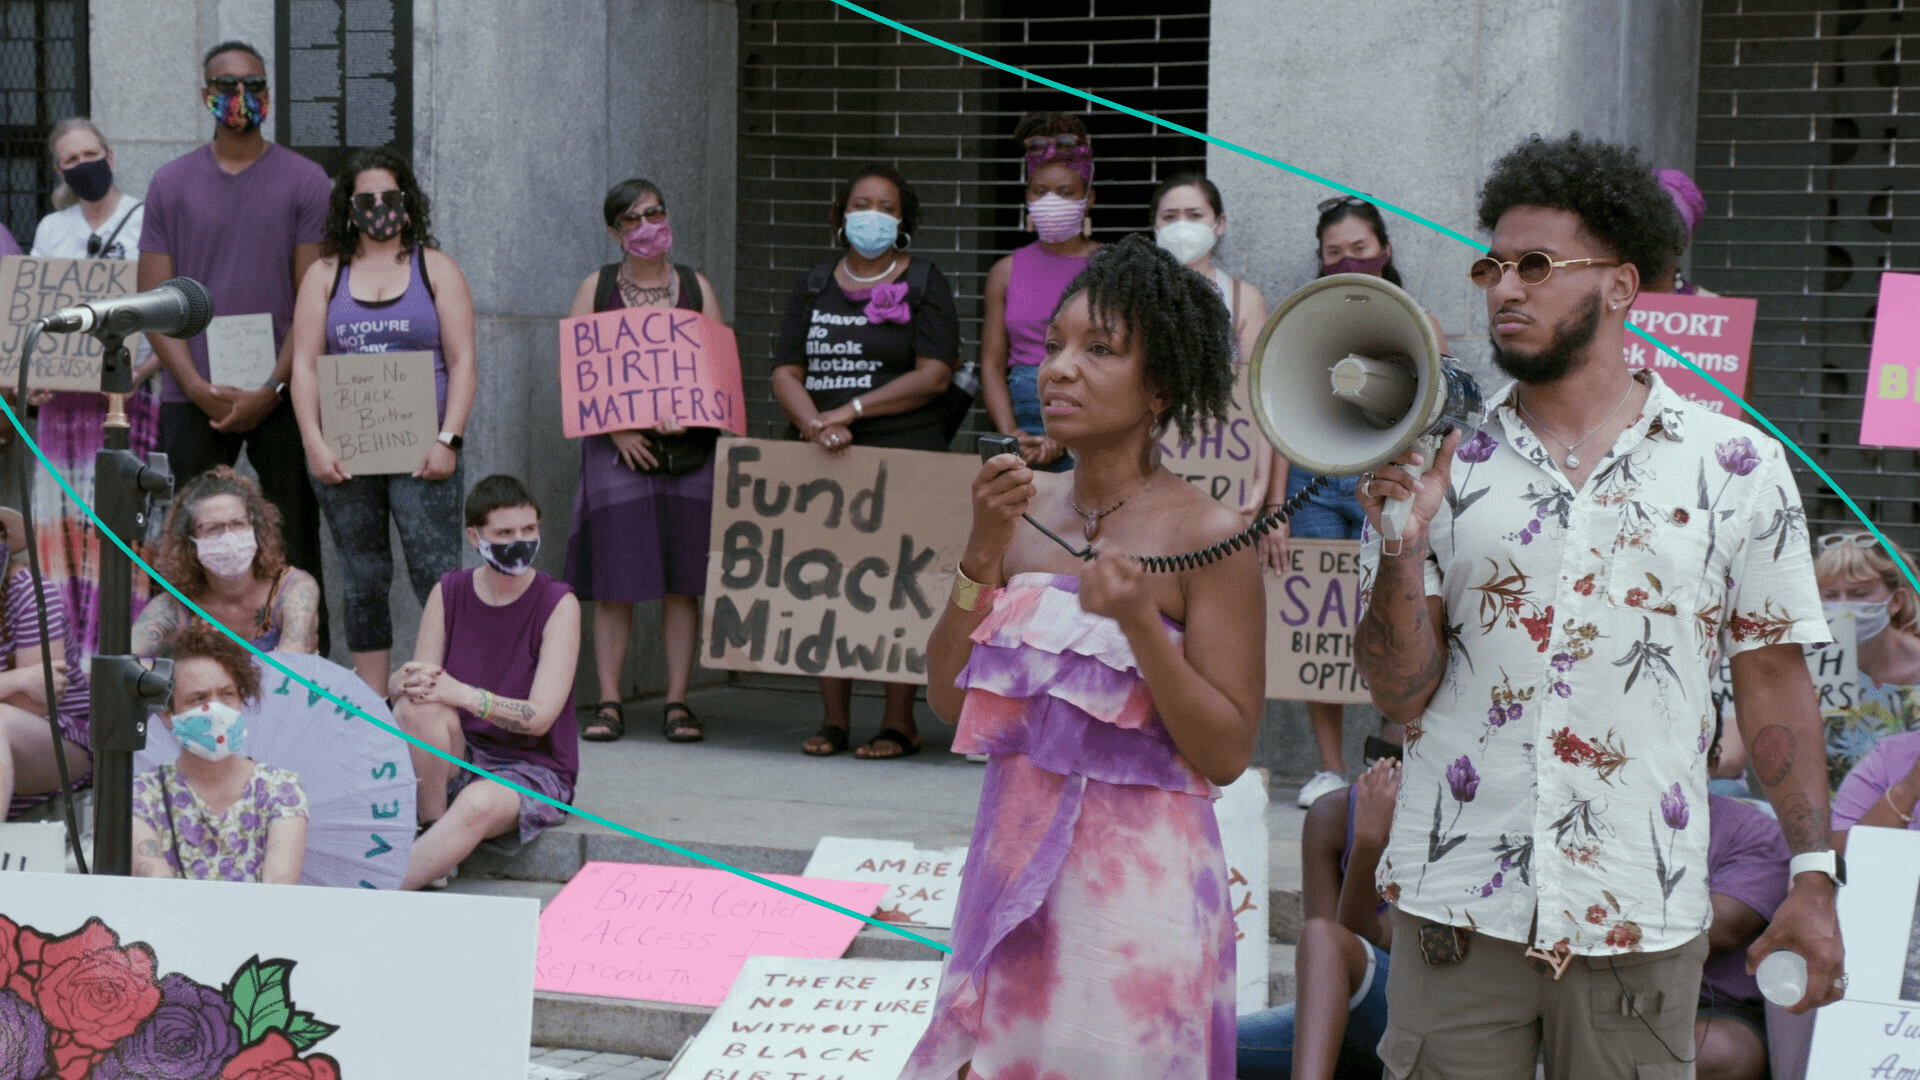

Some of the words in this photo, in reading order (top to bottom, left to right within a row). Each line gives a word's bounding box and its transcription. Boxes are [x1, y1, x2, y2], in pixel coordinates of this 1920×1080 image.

[14, 259, 128, 294] BLACK
[335, 324, 346, 337] IF
[350, 319, 410, 334] YOU'RE
[811, 309, 868, 326] Leave
[1627, 309, 1730, 337] PPORT
[338, 333, 366, 347] NOT
[574, 312, 701, 357] BLACK
[807, 325, 829, 339] No
[805, 340, 863, 355] Black
[808, 357, 883, 371] Mother
[1654, 345, 1740, 373] Moms
[383, 359, 407, 383] No
[576, 349, 698, 392] BIRTH
[805, 374, 872, 391] Behind
[334, 388, 395, 410] BLACK
[578, 386, 734, 431] MATTERS!
[333, 430, 418, 461] BEHIND
[725, 445, 888, 534] Fund
[721, 520, 936, 620] Black
[596, 871, 693, 914] Birth
[765, 973, 877, 990] THERE
[906, 977, 934, 991] IS
[749, 996, 795, 1010] NO
[813, 999, 930, 1014] FUTURE
[732, 1021, 888, 1036] WITHOUT
[722, 1042, 874, 1061] BLACK
